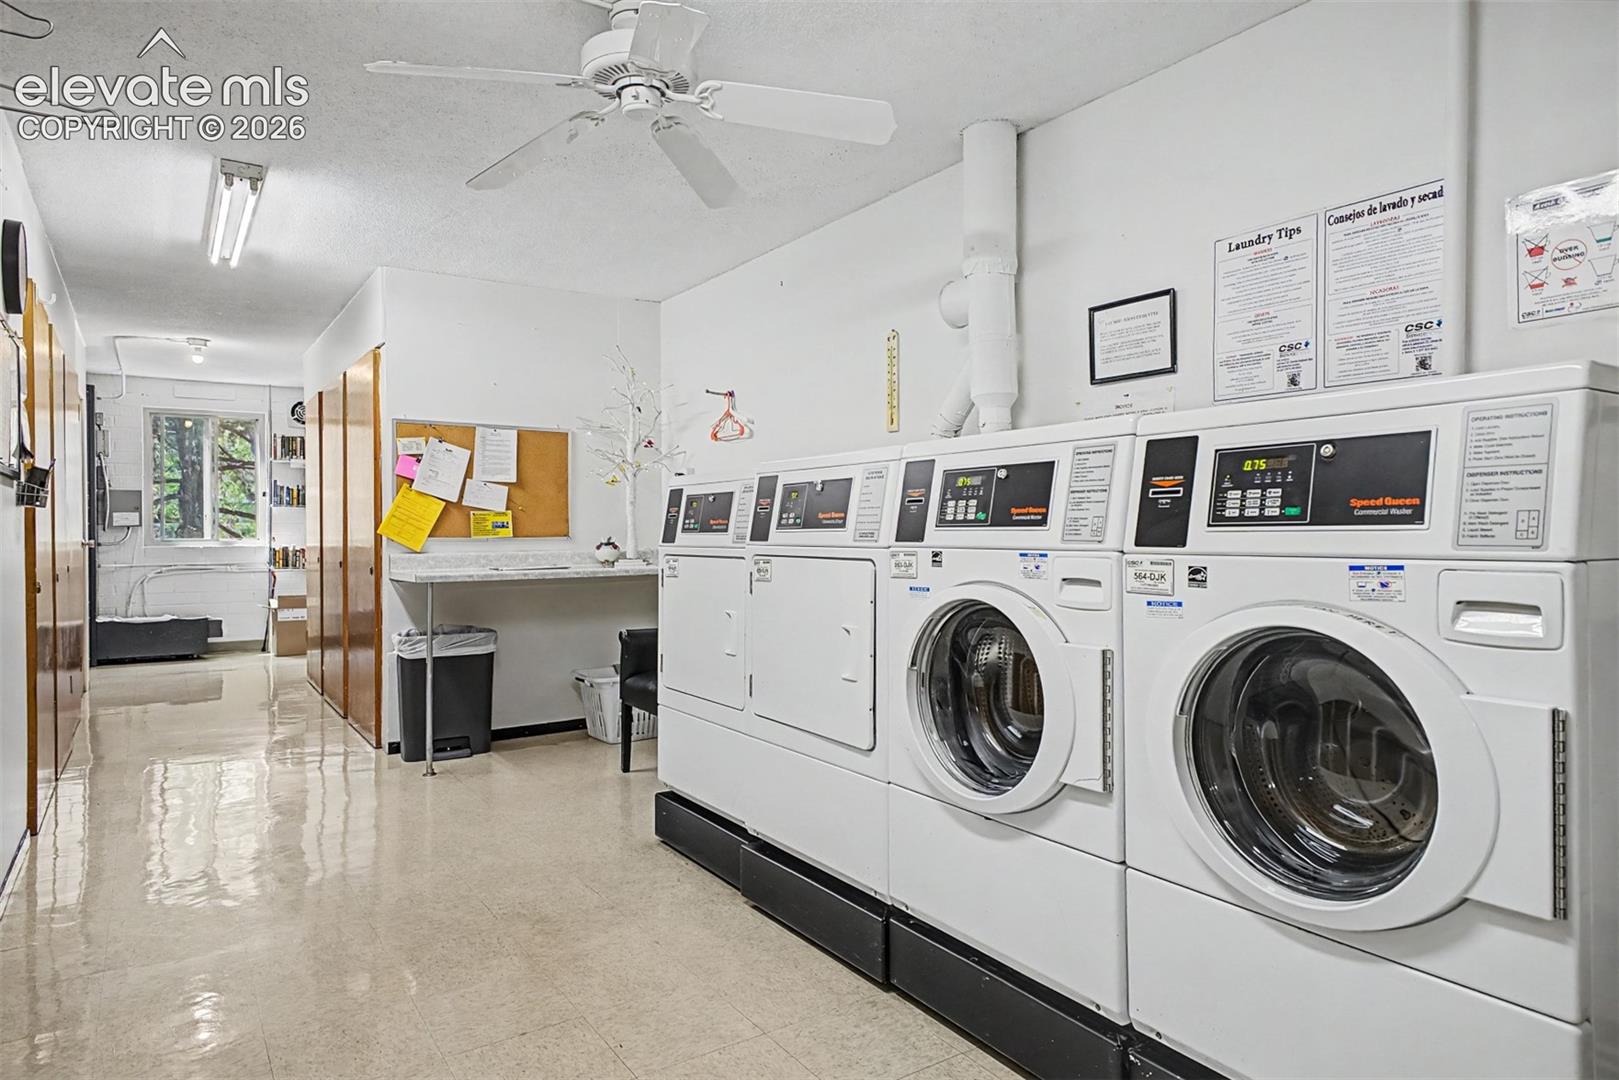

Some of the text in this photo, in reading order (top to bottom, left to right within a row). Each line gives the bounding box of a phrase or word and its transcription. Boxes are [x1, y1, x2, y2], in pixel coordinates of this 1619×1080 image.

[1327, 185, 1444, 226] Consejos de lavado y secad
[1228, 226, 1302, 253] Laundry Tips
[1404, 320, 1434, 332] CSC
[1278, 342, 1302, 352] CSC
[1349, 497, 1420, 507] Speed Queen
[1354, 508, 1389, 516] Commercial
[1134, 573, 1166, 582] 564-DJK
